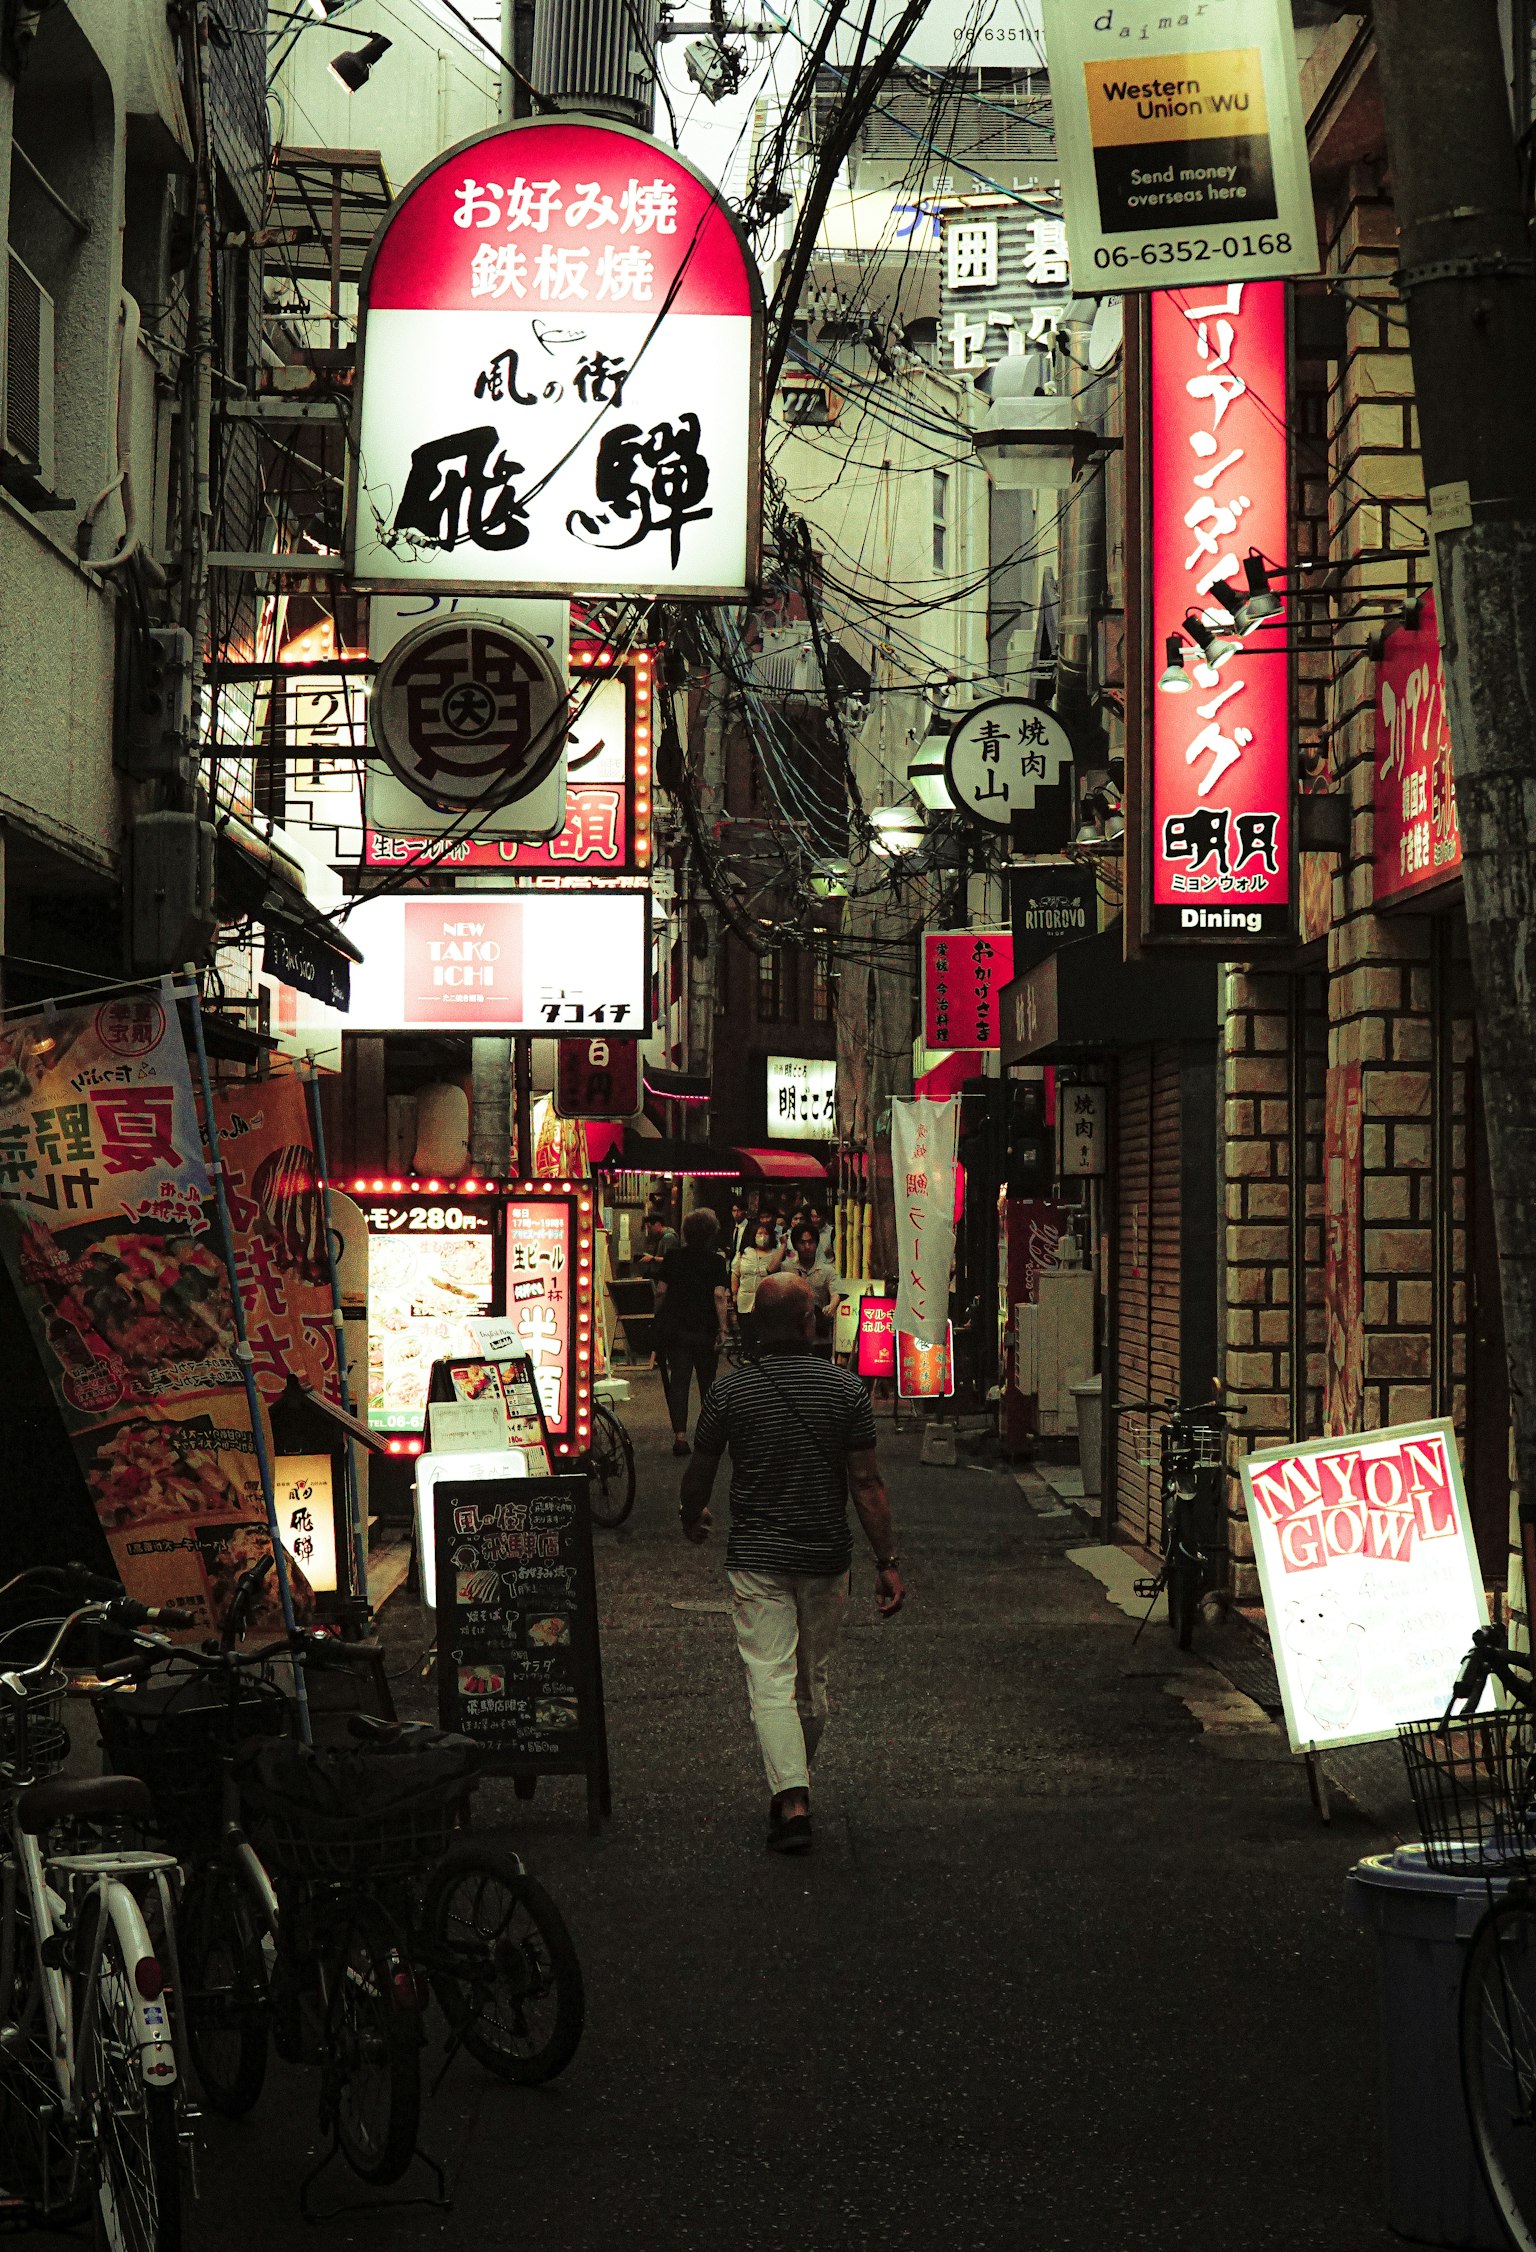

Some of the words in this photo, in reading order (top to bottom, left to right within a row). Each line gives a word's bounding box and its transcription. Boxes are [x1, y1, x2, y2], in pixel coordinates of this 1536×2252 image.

[954, 28, 1045, 42] 06(6351)1
[1094, 4, 1208, 41] daimar
[1102, 79, 1200, 101] Western
[1137, 98, 1203, 119] Union
[1131, 165, 1175, 186] Send
[1180, 164, 1237, 183] money
[452, 176, 678, 235] お好み焼
[1128, 189, 1203, 208] overseas
[1207, 183, 1248, 201] here
[948, 219, 1070, 289] 囲碁
[1094, 233, 1292, 269] 06-6352-0168
[470, 243, 654, 301] 鉄板焼
[474, 349, 629, 408] 風の街
[970, 720, 1011, 802] 青山
[1018, 716, 1049, 780] 焼肉
[1162, 806, 1281, 874] 明月
[1171, 873, 1269, 894] ミョンウォル
[443, 921, 486, 938] NEW
[1181, 908, 1263, 932] Dining
[426, 940, 501, 962] TAKO
[433, 965, 495, 987] ICHI
[540, 1003, 632, 1024] タコイチ
[779, 1084, 835, 1121] 明ごころ
[1073, 1094, 1097, 1140] 焼肉
[362, 1207, 488, 1231] モン280円～
[512, 1240, 565, 1273] 生ビール
[1254, 1440, 1449, 1521] MYON
[1281, 1490, 1454, 1569] GOWL
[521, 1658, 556, 1672] サラダ
